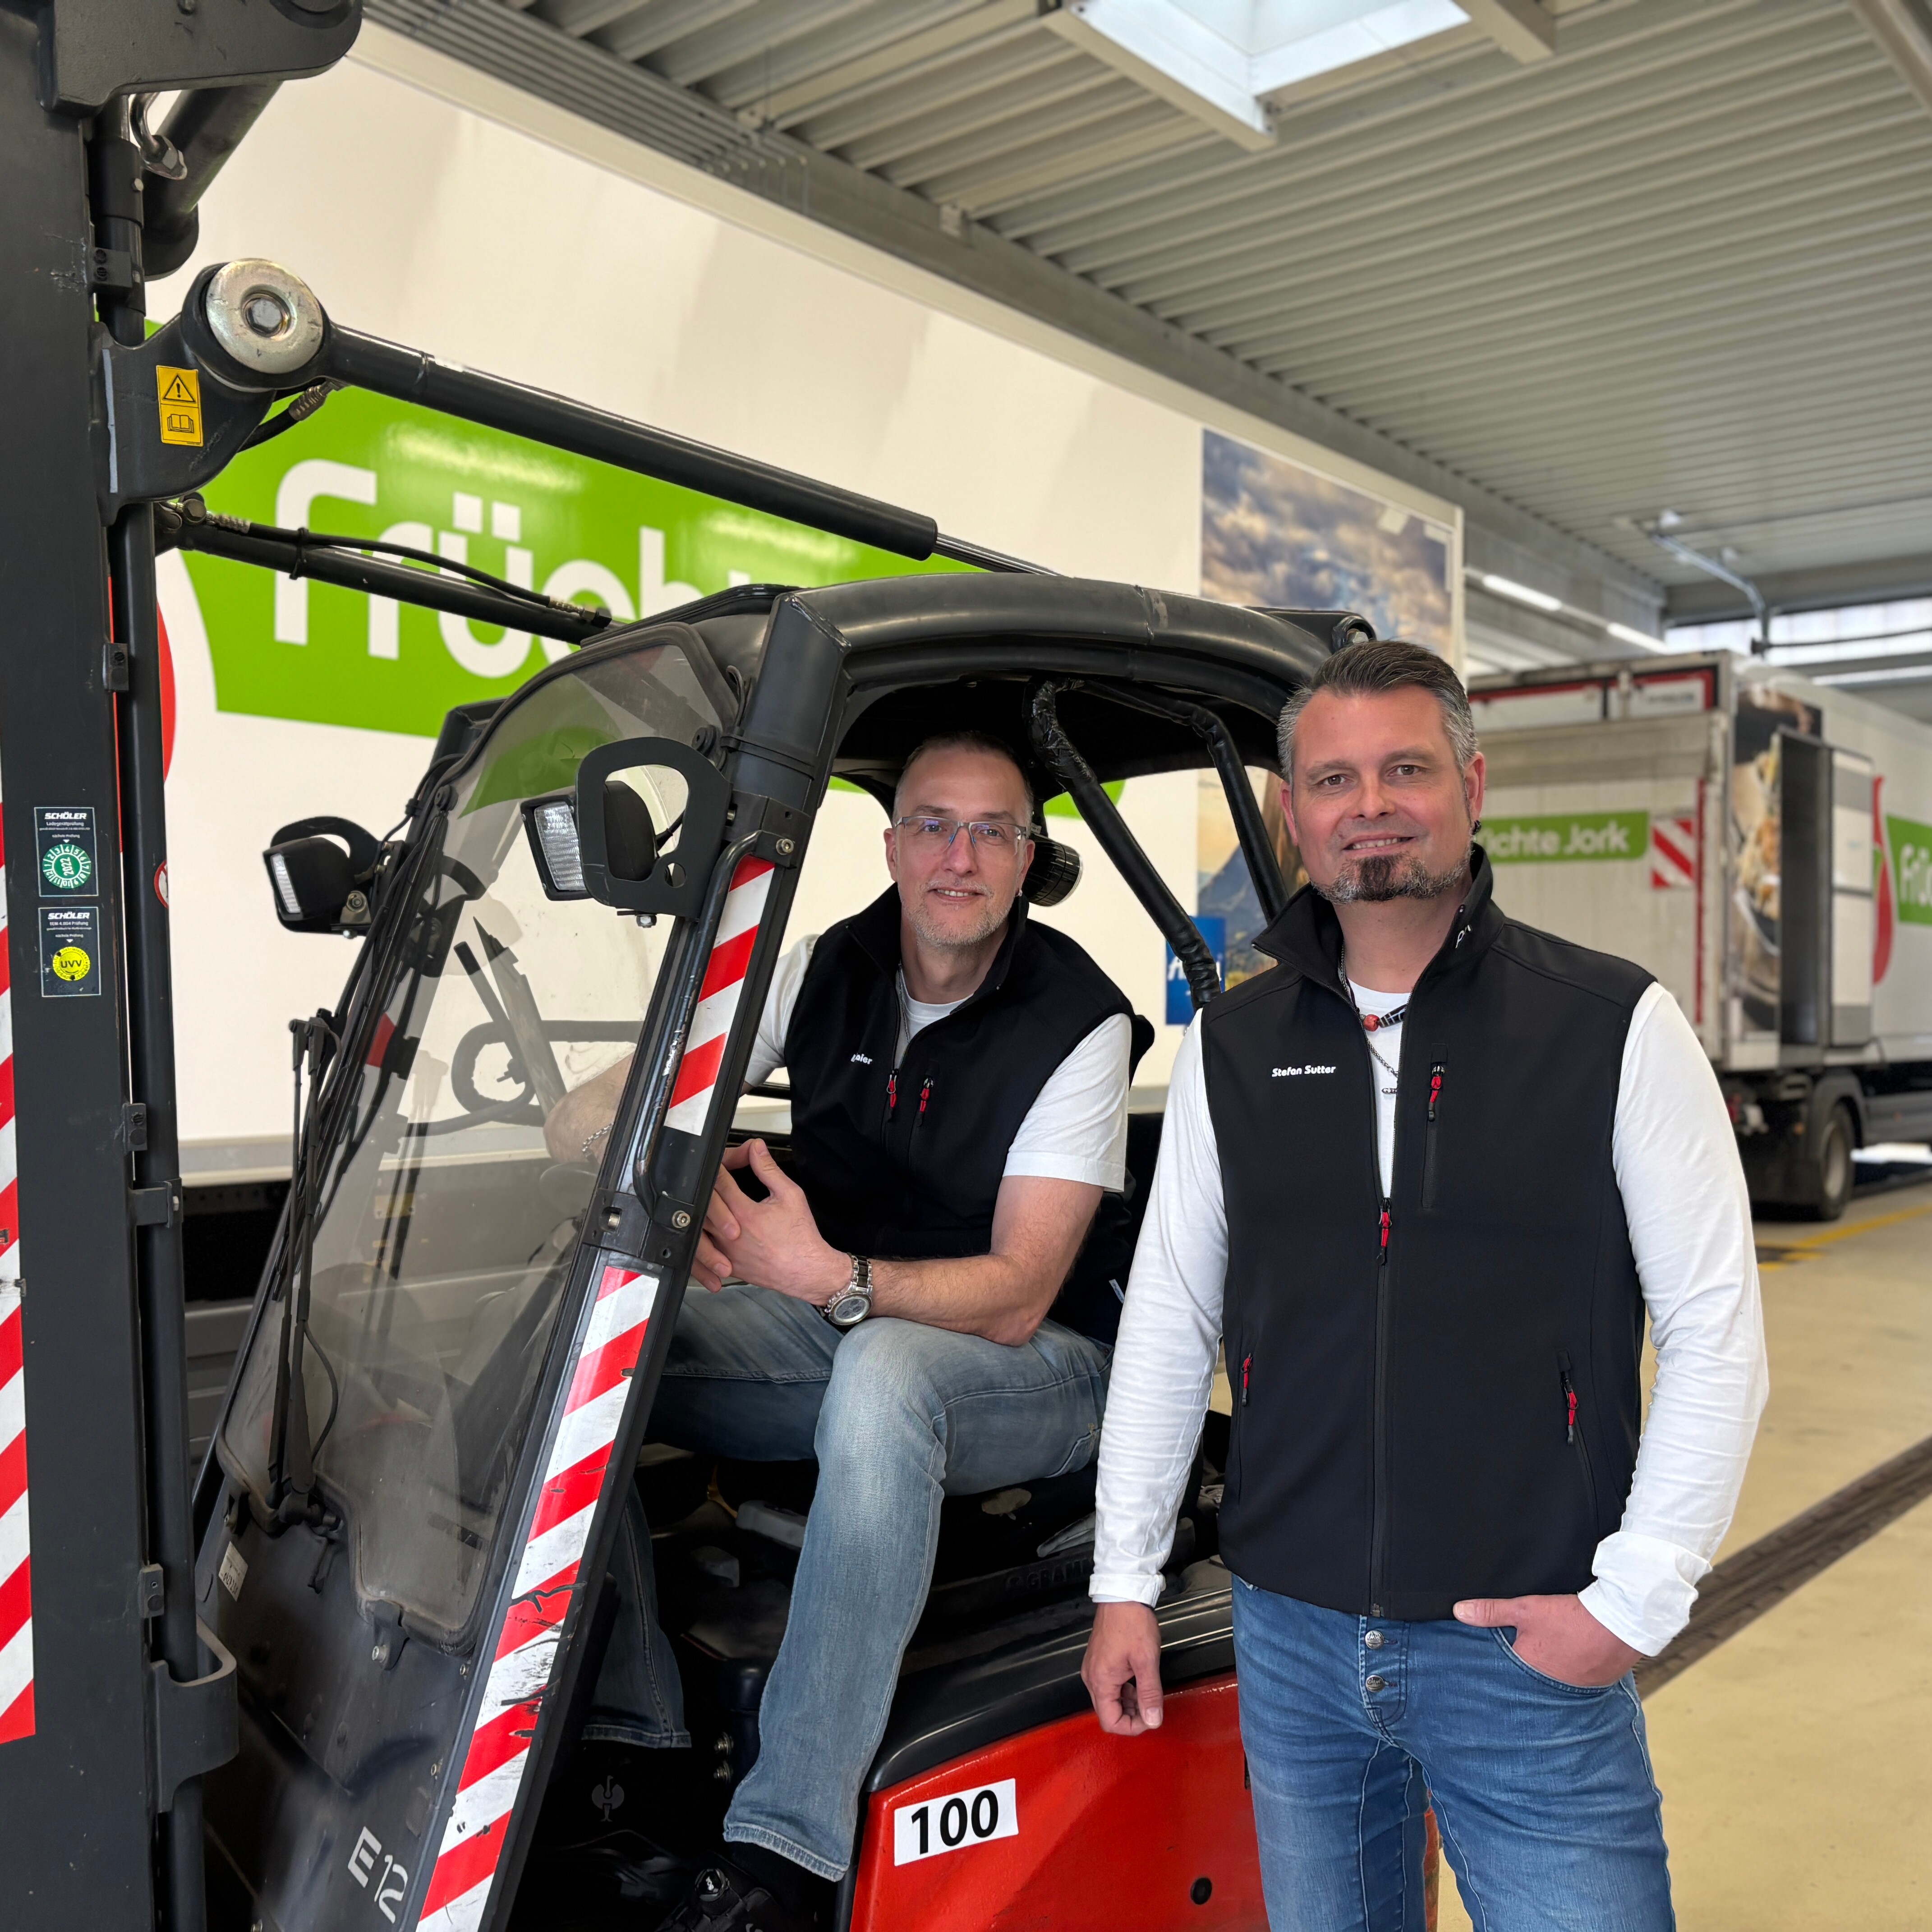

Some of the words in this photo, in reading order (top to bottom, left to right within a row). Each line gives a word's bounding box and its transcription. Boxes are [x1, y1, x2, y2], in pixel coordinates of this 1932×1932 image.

[44, 811, 87, 819] SCHÖLER
[1564, 818, 1629, 854] Jork
[60, 857, 74, 876] 2022
[48, 911, 90, 920] SCHÖLER
[60, 959, 82, 968] UVV
[1271, 1066, 1302, 1077] Stefan
[1304, 1065, 1336, 1075] Sutter
[911, 1789, 999, 1855] 100
